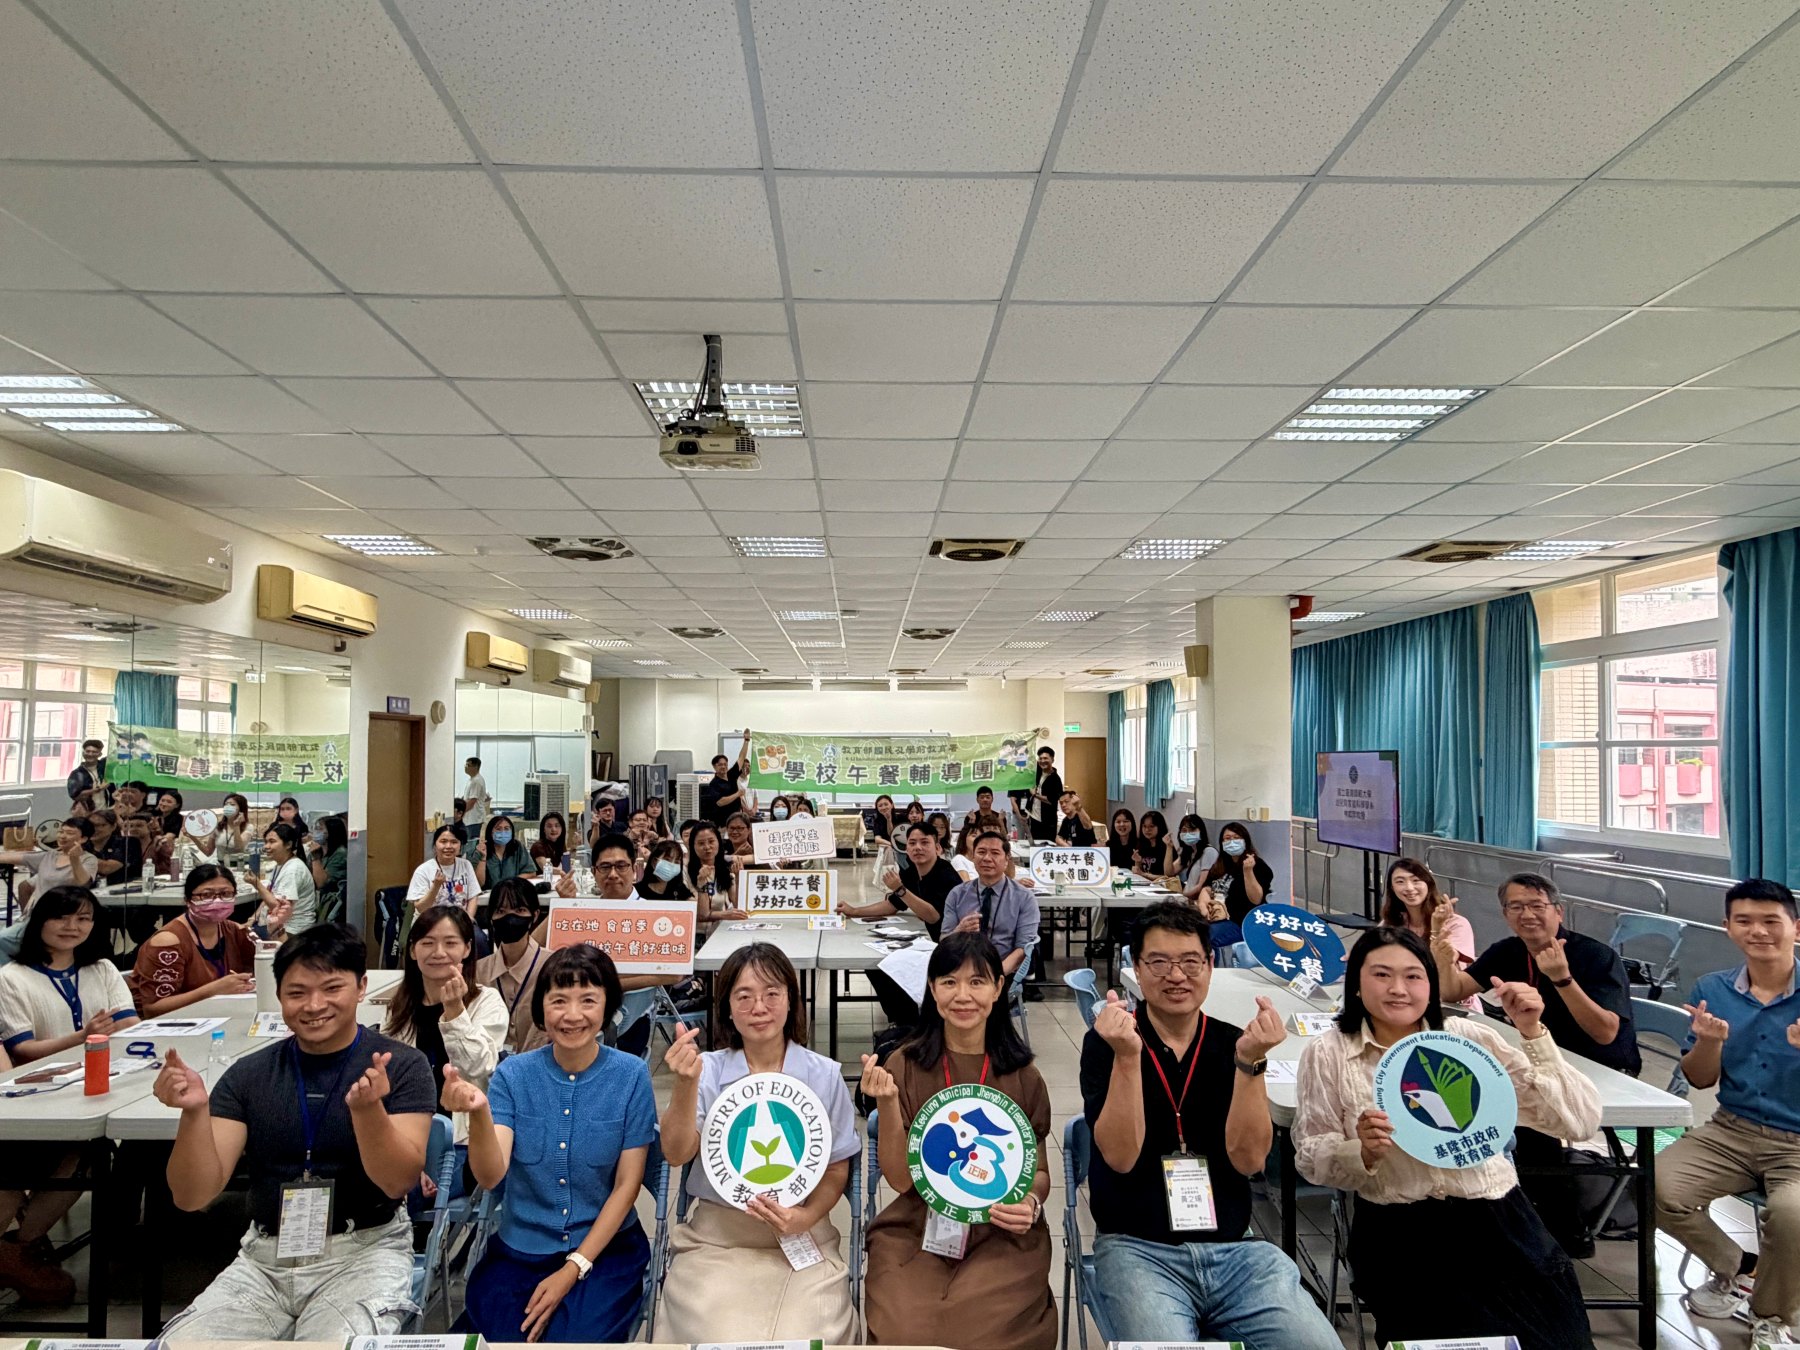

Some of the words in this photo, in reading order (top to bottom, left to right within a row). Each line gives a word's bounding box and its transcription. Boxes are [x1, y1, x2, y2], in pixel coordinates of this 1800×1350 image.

[783, 759, 994, 786] 學校午餐輔導團
[768, 829, 819, 844] 提升學生
[1042, 851, 1096, 866] 學校午餐
[755, 874, 821, 891] 學校午餐
[753, 894, 804, 908] 好好吃
[555, 918, 600, 932] 吃在地
[606, 918, 648, 934] 食當季
[1253, 909, 1328, 937] 好好吃
[1272, 952, 1325, 982] 午餐
[1419, 1033, 1461, 1044] Education
[1380, 1036, 1420, 1069] Government
[1462, 1039, 1504, 1078] Department
[1375, 1069, 1387, 1086] City
[1376, 1087, 1385, 1112] elung
[708, 1092, 741, 1187] MINISTRY
[741, 1081, 765, 1100] OF
[769, 1081, 824, 1173] EDUCATION
[913, 1098, 940, 1130] Keelung
[937, 1085, 974, 1103] Municipal
[976, 1087, 1009, 1108] Jhengbin
[1007, 1104, 1034, 1145] Elementary
[1022, 1148, 1037, 1180] School
[1433, 1125, 1501, 1159] 基隆市政府
[1452, 1143, 1496, 1168] 教育處
[732, 1173, 808, 1204] 教育部
[908, 1133, 1027, 1223] 基隆市正濱小
